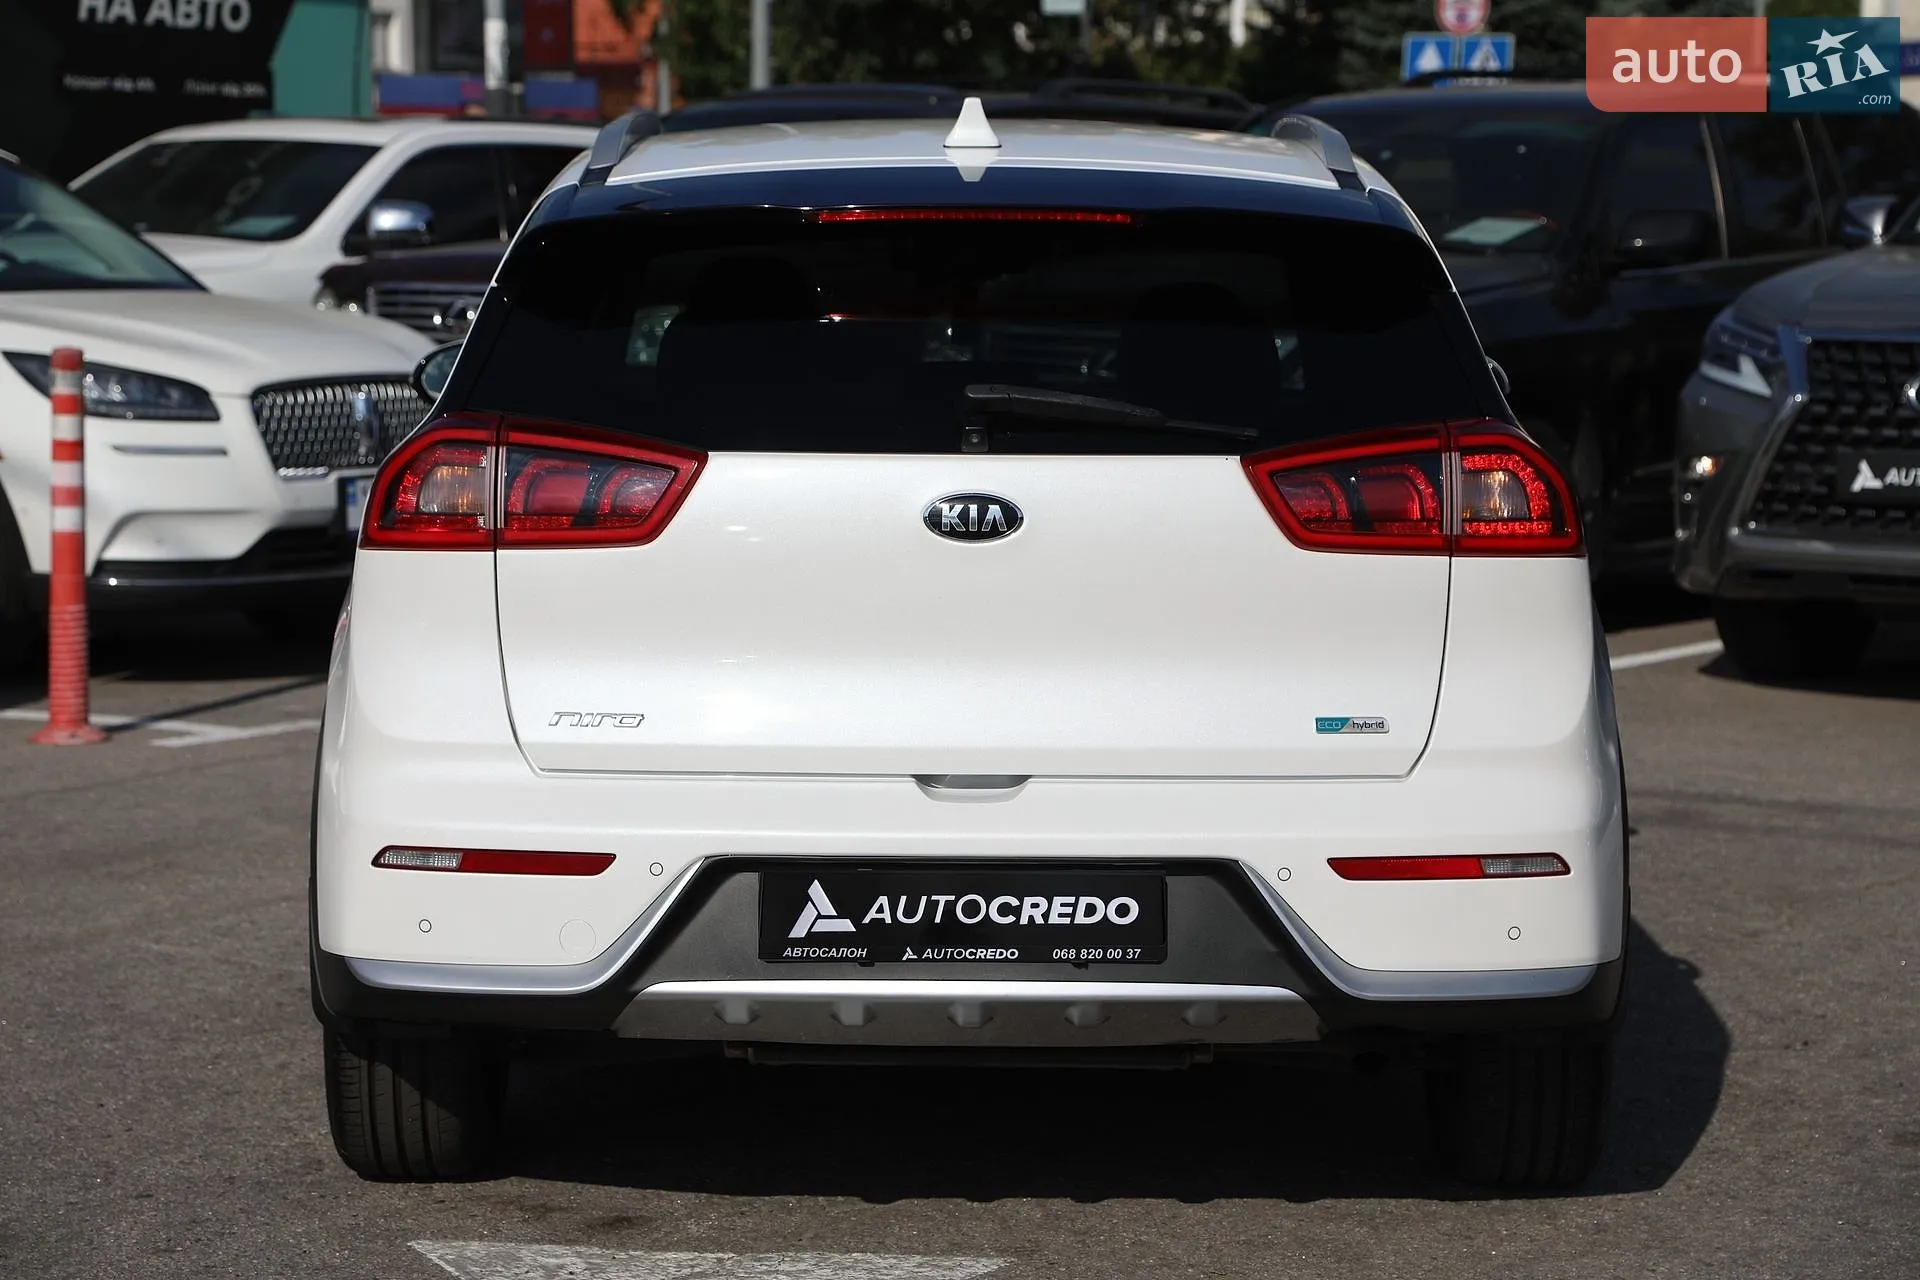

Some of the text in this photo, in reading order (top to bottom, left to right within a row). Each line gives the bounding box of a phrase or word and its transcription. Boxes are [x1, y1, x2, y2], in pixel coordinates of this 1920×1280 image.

[76, 0, 252, 33] НА АВТО
[941, 504, 1007, 531] KIA
[1352, 720, 1384, 730] hybrid
[861, 893, 1140, 925] AUTOCREDO
[782, 947, 868, 958] АВТОСАЛОН
[921, 948, 1019, 960] AUTOCREDO
[1052, 948, 1141, 960] 068 820 00 37
